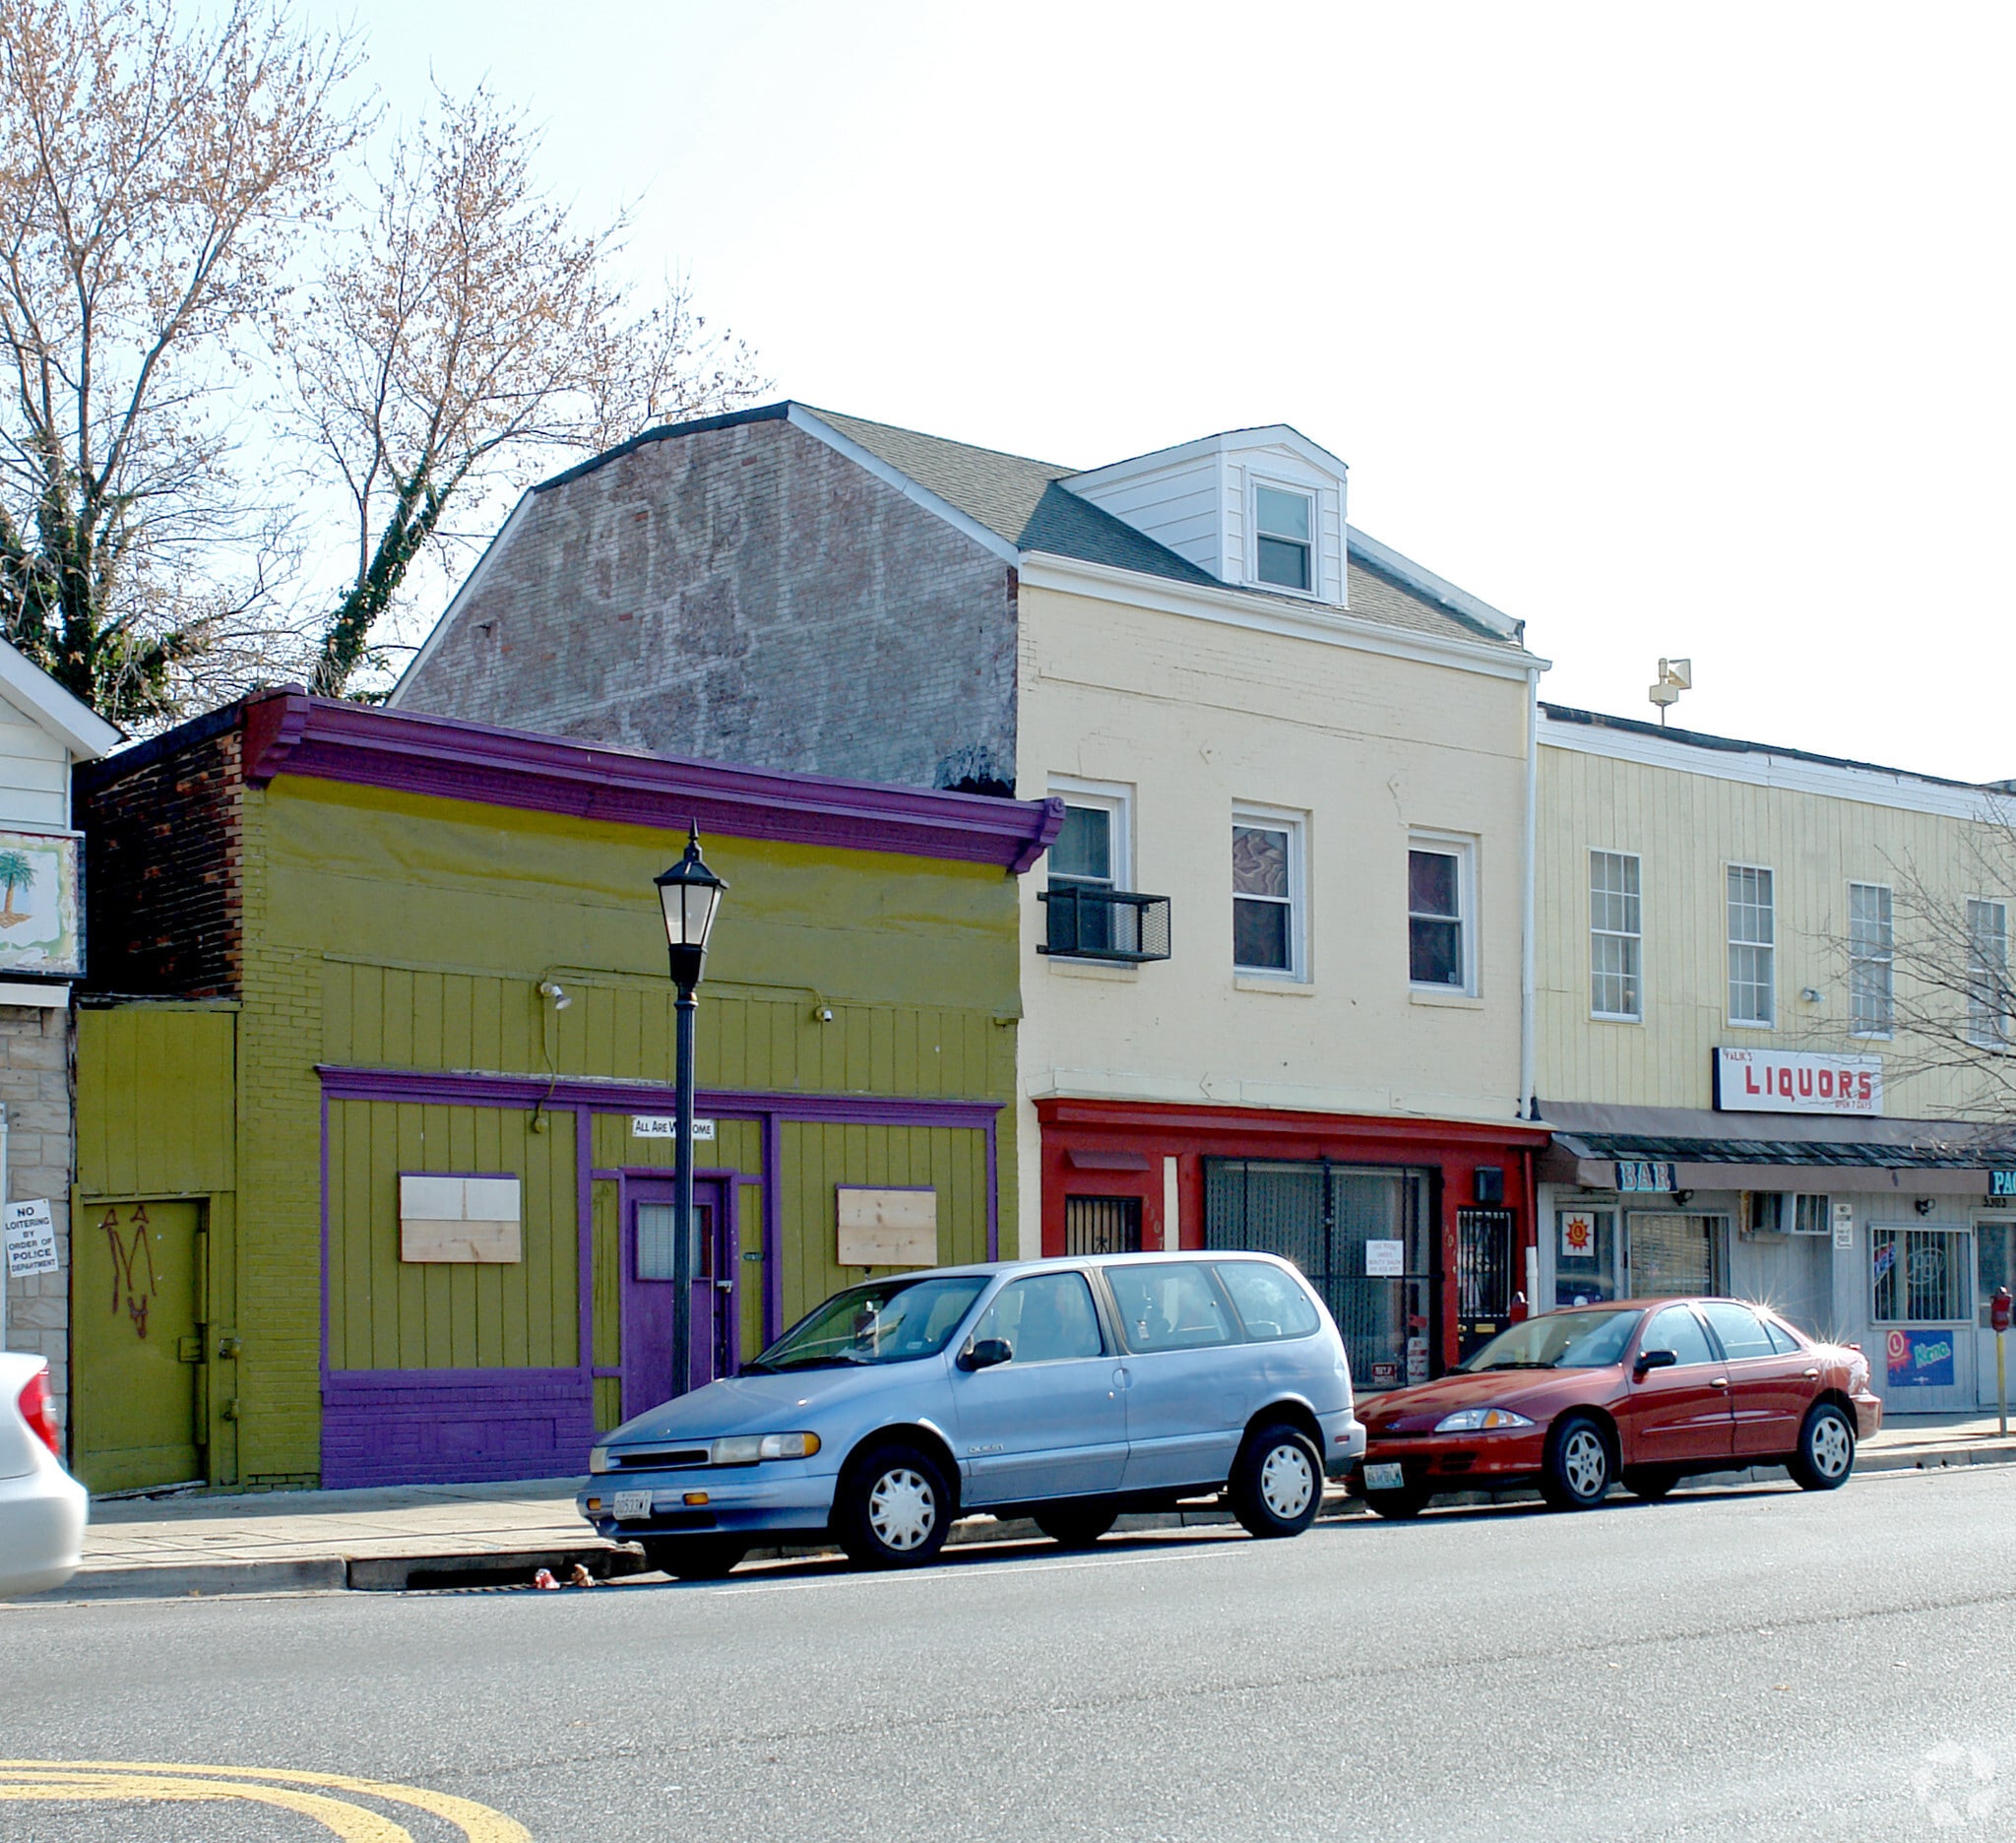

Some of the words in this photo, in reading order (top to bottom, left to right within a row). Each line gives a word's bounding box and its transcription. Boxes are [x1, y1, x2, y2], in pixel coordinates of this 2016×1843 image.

[1745, 1065, 1872, 1103] LIQUORS
[635, 1120, 650, 1132] ALL
[652, 1120, 668, 1133] ARE
[668, 1120, 712, 1135] WOME
[1619, 1162, 1671, 1191] BAR
[17, 1207, 34, 1217] NO
[5, 1217, 50, 1230] LOITERING
[23, 1230, 35, 1239] BY
[9, 1239, 37, 1250] ORDER
[41, 1238, 52, 1246] OF
[13, 1248, 52, 1261] POLICE
[12, 1259, 56, 1272] DEPARTMENT
